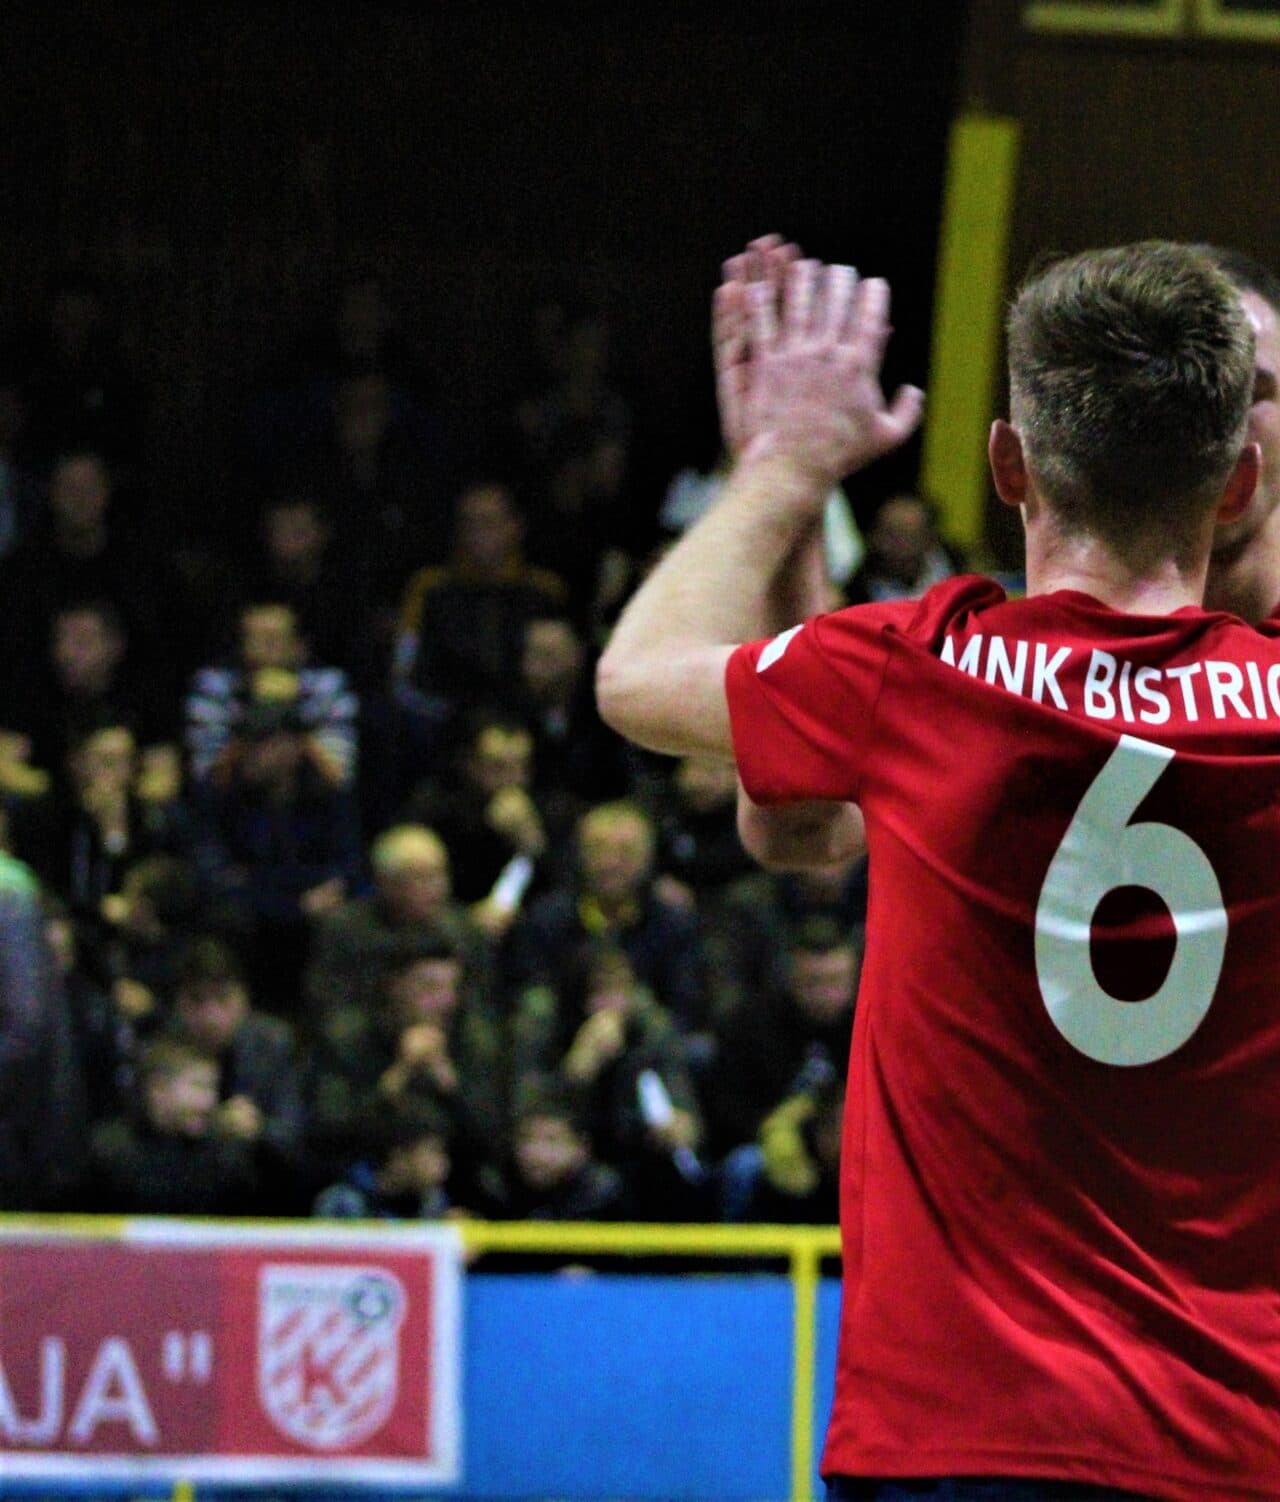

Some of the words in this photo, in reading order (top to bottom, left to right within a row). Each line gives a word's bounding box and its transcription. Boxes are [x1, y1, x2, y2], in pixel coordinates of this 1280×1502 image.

[940, 634, 1072, 711] MNK
[1034, 733, 1229, 1067] 6
[0, 1330, 213, 1446] JA"
